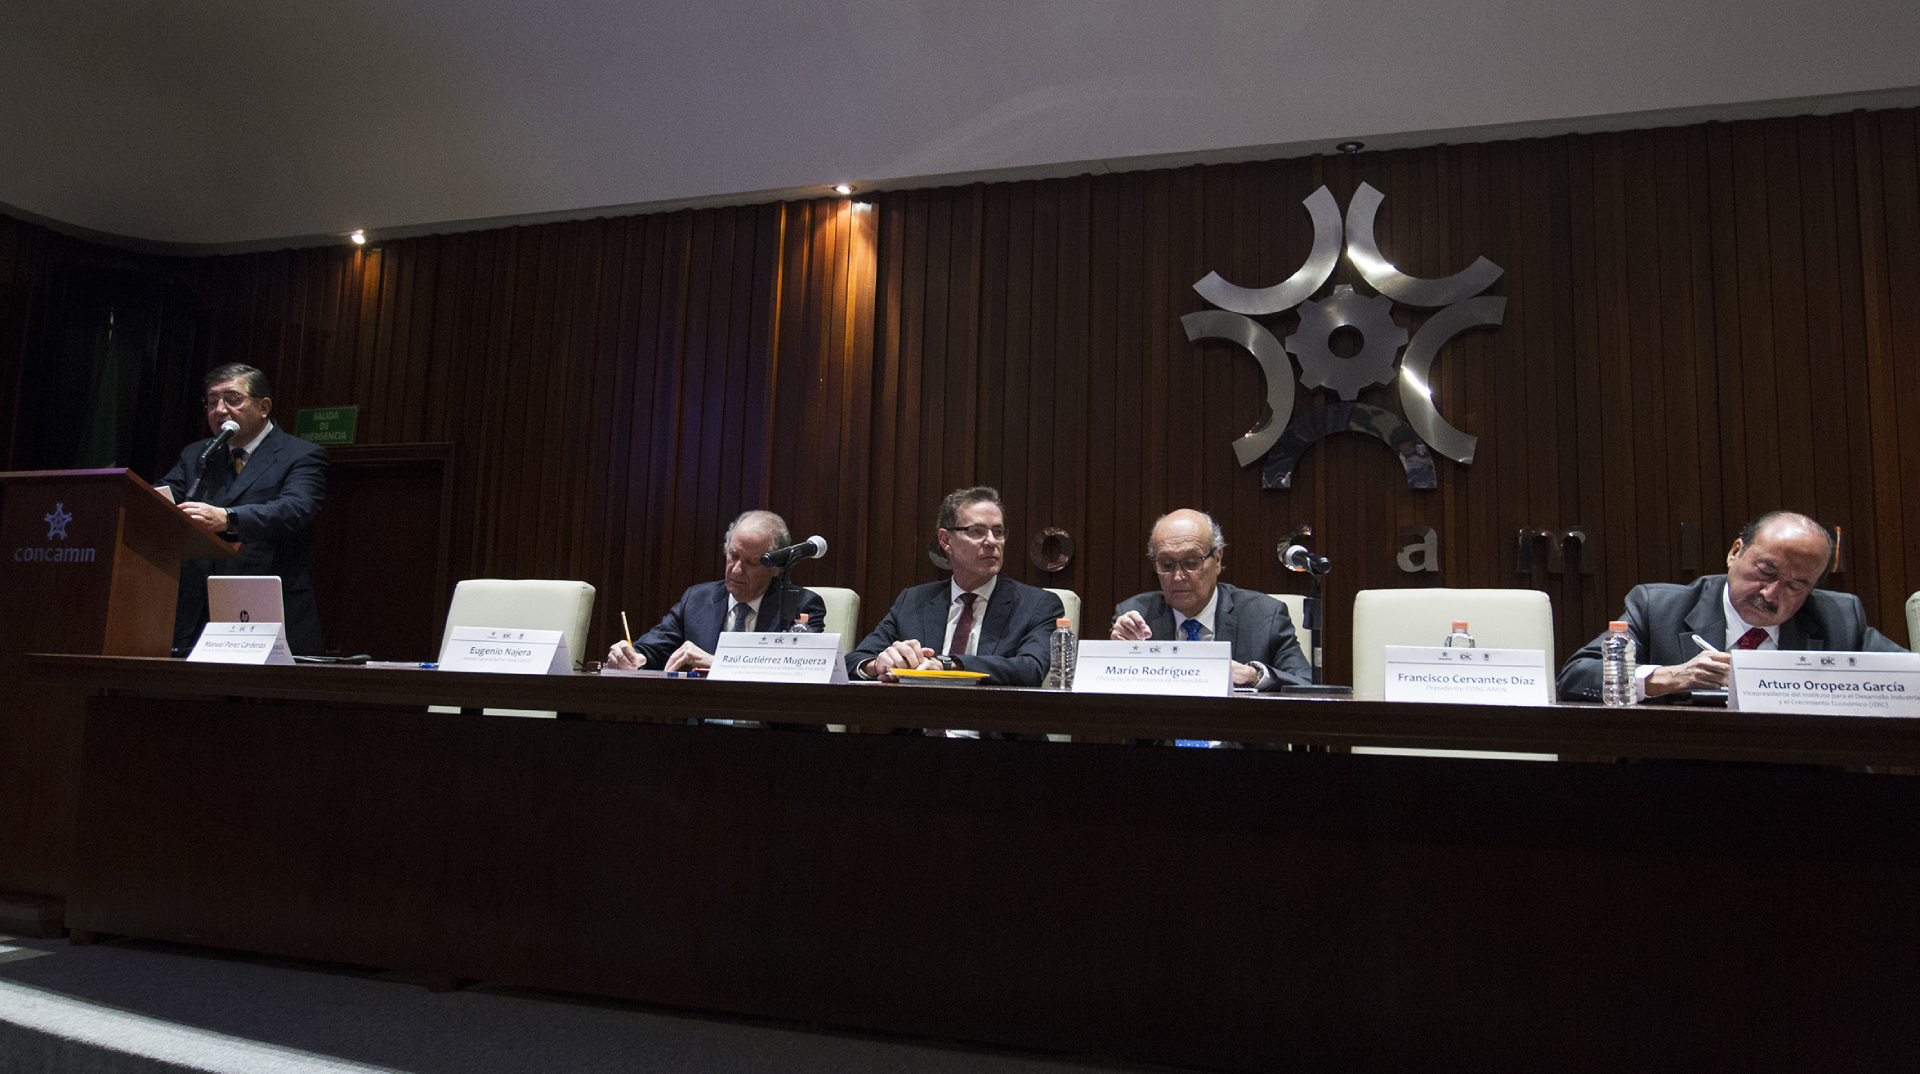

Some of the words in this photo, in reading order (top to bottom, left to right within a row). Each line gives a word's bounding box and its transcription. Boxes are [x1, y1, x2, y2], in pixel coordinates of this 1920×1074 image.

[313, 411, 339, 420] SALIDA
[319, 421, 330, 431] DE
[14, 547, 96, 563] concamin
[470, 646, 503, 657] Eugenio
[505, 648, 532, 658] Najera
[722, 655, 741, 663] Raúl
[742, 655, 782, 664] Gutiérrez
[783, 657, 827, 667] Muguerza
[1105, 666, 1139, 676] Mario
[1142, 666, 1200, 678] Rodríguez
[1398, 673, 1450, 683] Francisco
[1452, 674, 1508, 684] Cervantes
[1511, 675, 1535, 685] Díaz
[1465, 685, 1507, 693] CONCAMIN
[1758, 679, 1801, 690] Arturo
[1804, 680, 1860, 693] Oropeza
[1862, 681, 1905, 692] García
